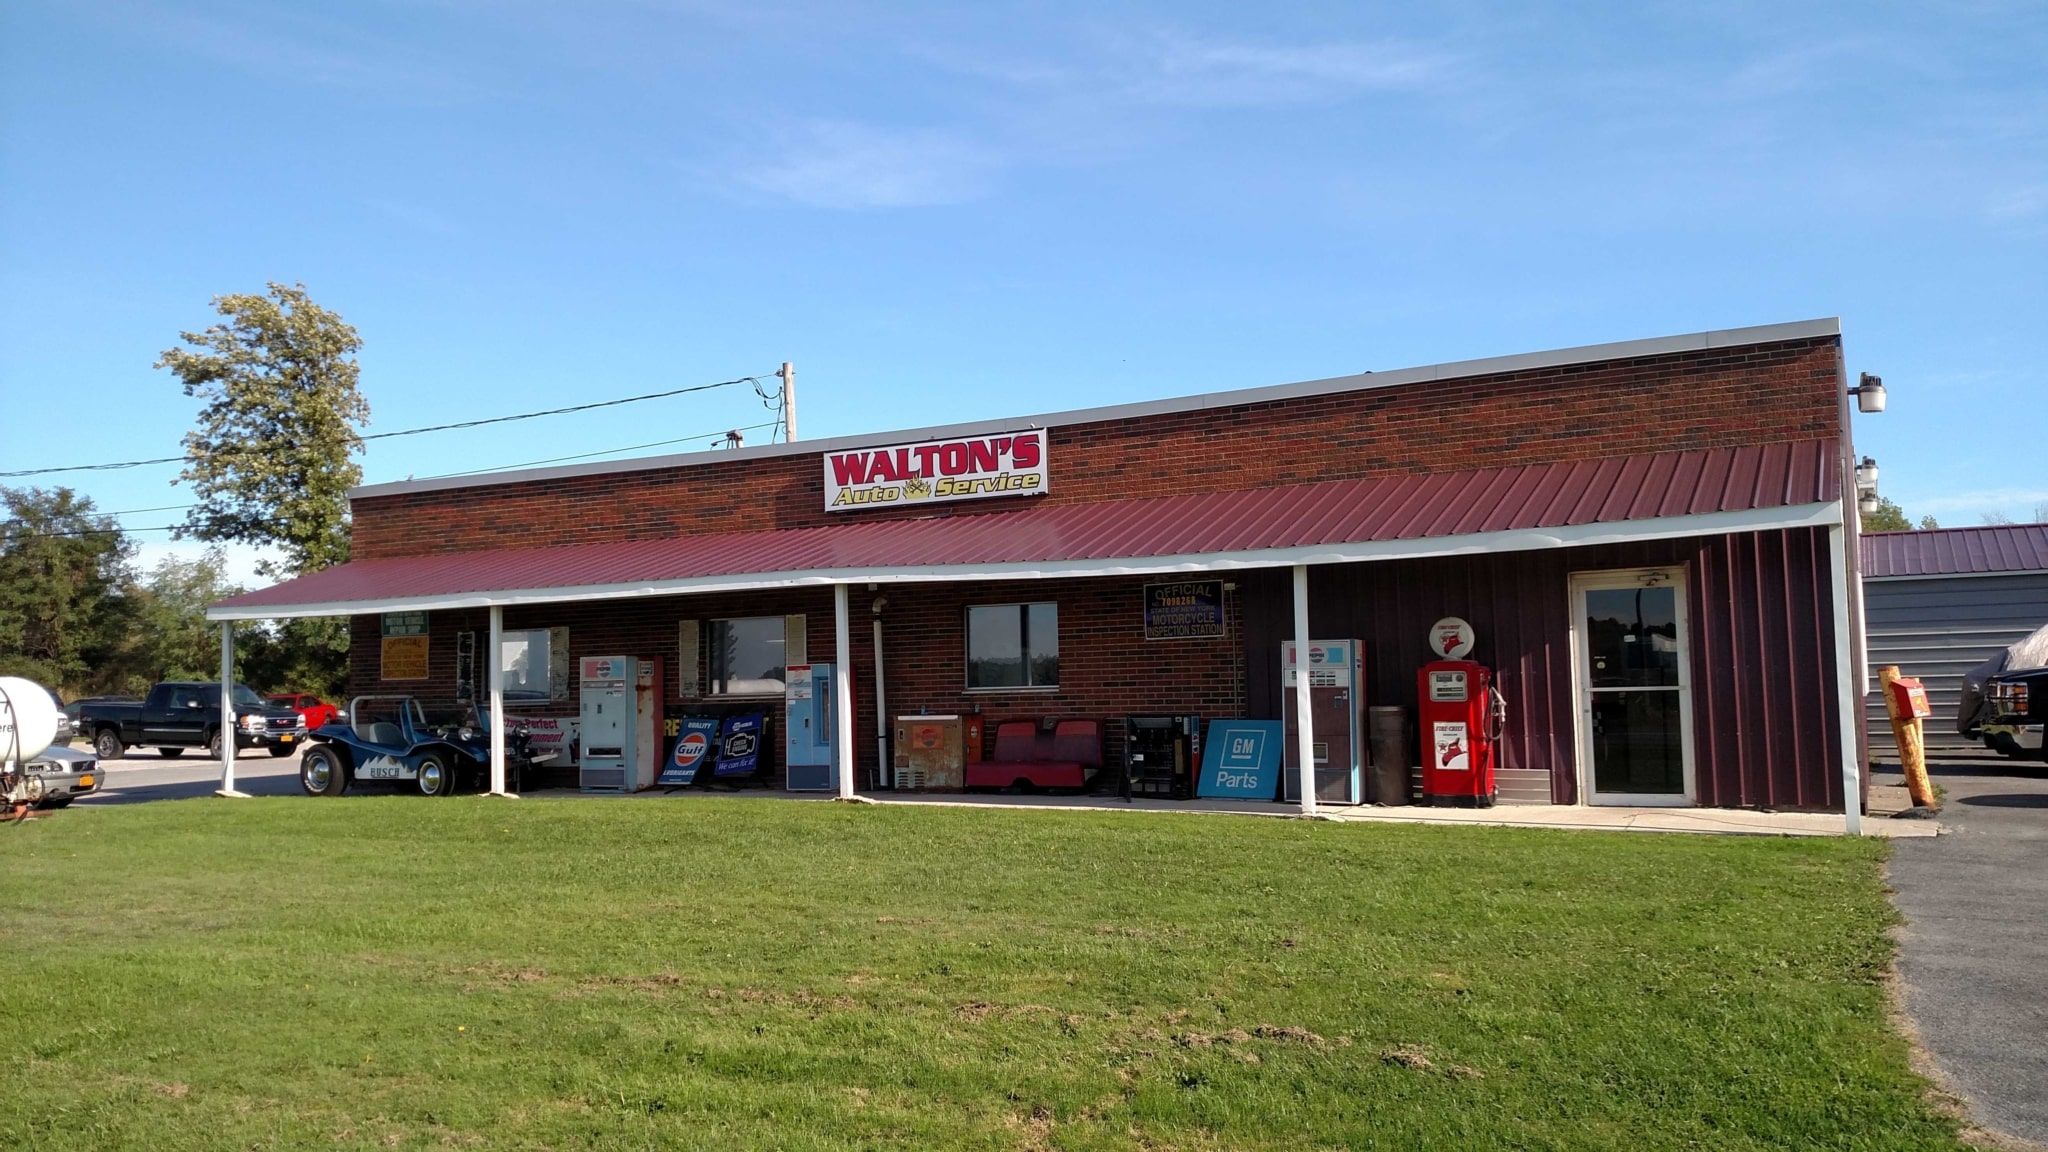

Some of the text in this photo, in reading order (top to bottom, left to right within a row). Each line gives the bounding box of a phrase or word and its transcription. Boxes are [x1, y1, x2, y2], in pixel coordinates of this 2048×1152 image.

[830, 433, 1040, 487] WALTON'S
[831, 472, 1041, 507] Auto Service
[1155, 583, 1213, 601] OFFICIAL
[1152, 612, 1215, 626] MOTORCYCLE
[1148, 623, 1222, 638] INSPECTION STATION
[387, 637, 422, 650] OFFICIAL
[524, 718, 559, 729] Perfect
[687, 721, 712, 730] QUALITY
[677, 744, 704, 755] Gulf
[1232, 738, 1255, 754] GM
[370, 767, 400, 777] BUSCH
[1215, 771, 1258, 789] Parts
